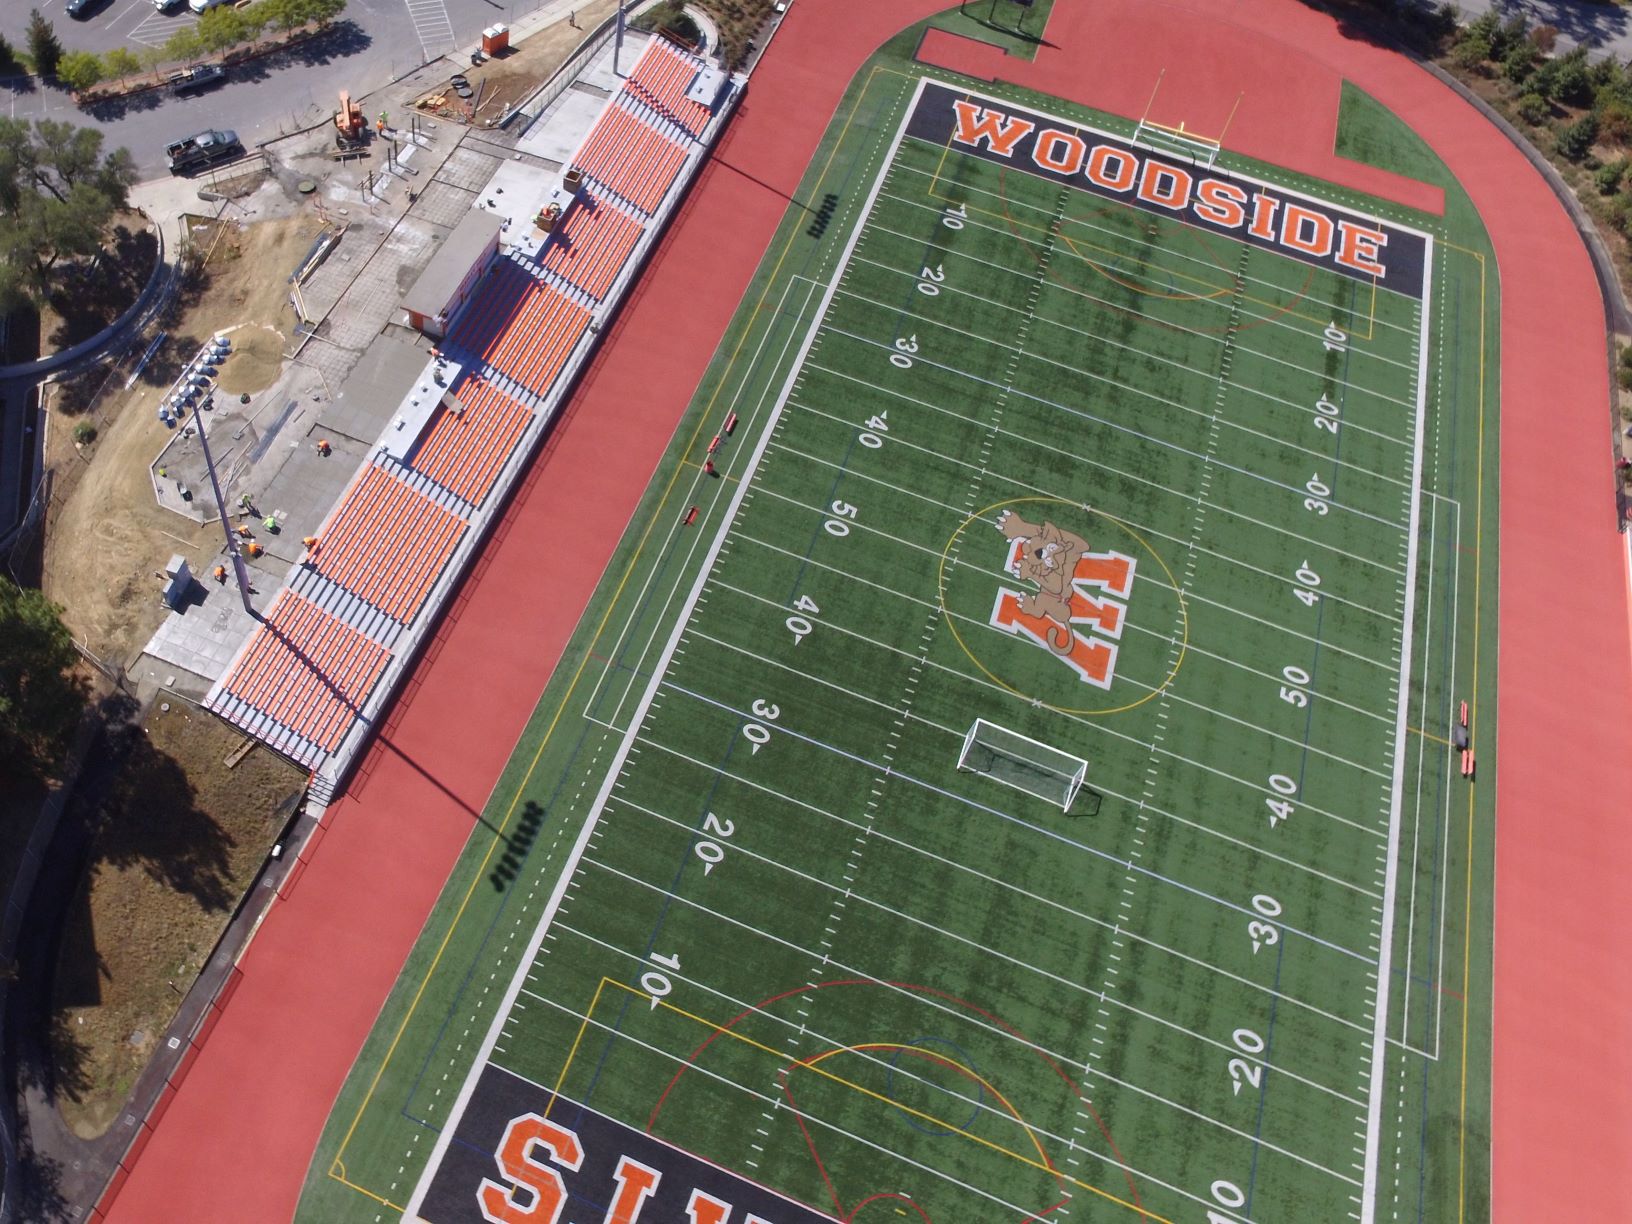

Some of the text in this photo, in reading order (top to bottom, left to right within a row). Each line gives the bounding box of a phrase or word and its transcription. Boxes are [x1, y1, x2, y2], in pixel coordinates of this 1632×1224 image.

[952, 100, 1388, 278] WOODSIDE
[942, 208, 968, 230] 10
[917, 266, 945, 296] 20
[889, 338, 919, 369] 30
[1323, 327, 1347, 353] 10
[858, 415, 889, 449] 40
[1313, 400, 1339, 434] 20
[1304, 479, 1330, 515] 30
[824, 500, 858, 537] 50
[1293, 568, 1321, 607] 40
[785, 594, 820, 637] 40
[1279, 665, 1309, 708] 50
[742, 698, 780, 745] 30
[1265, 774, 1297, 821] 40
[694, 812, 735, 863] 20
[1248, 894, 1282, 945] 30
[641, 952, 681, 996] 10
[1228, 1028, 1264, 1088] 20
